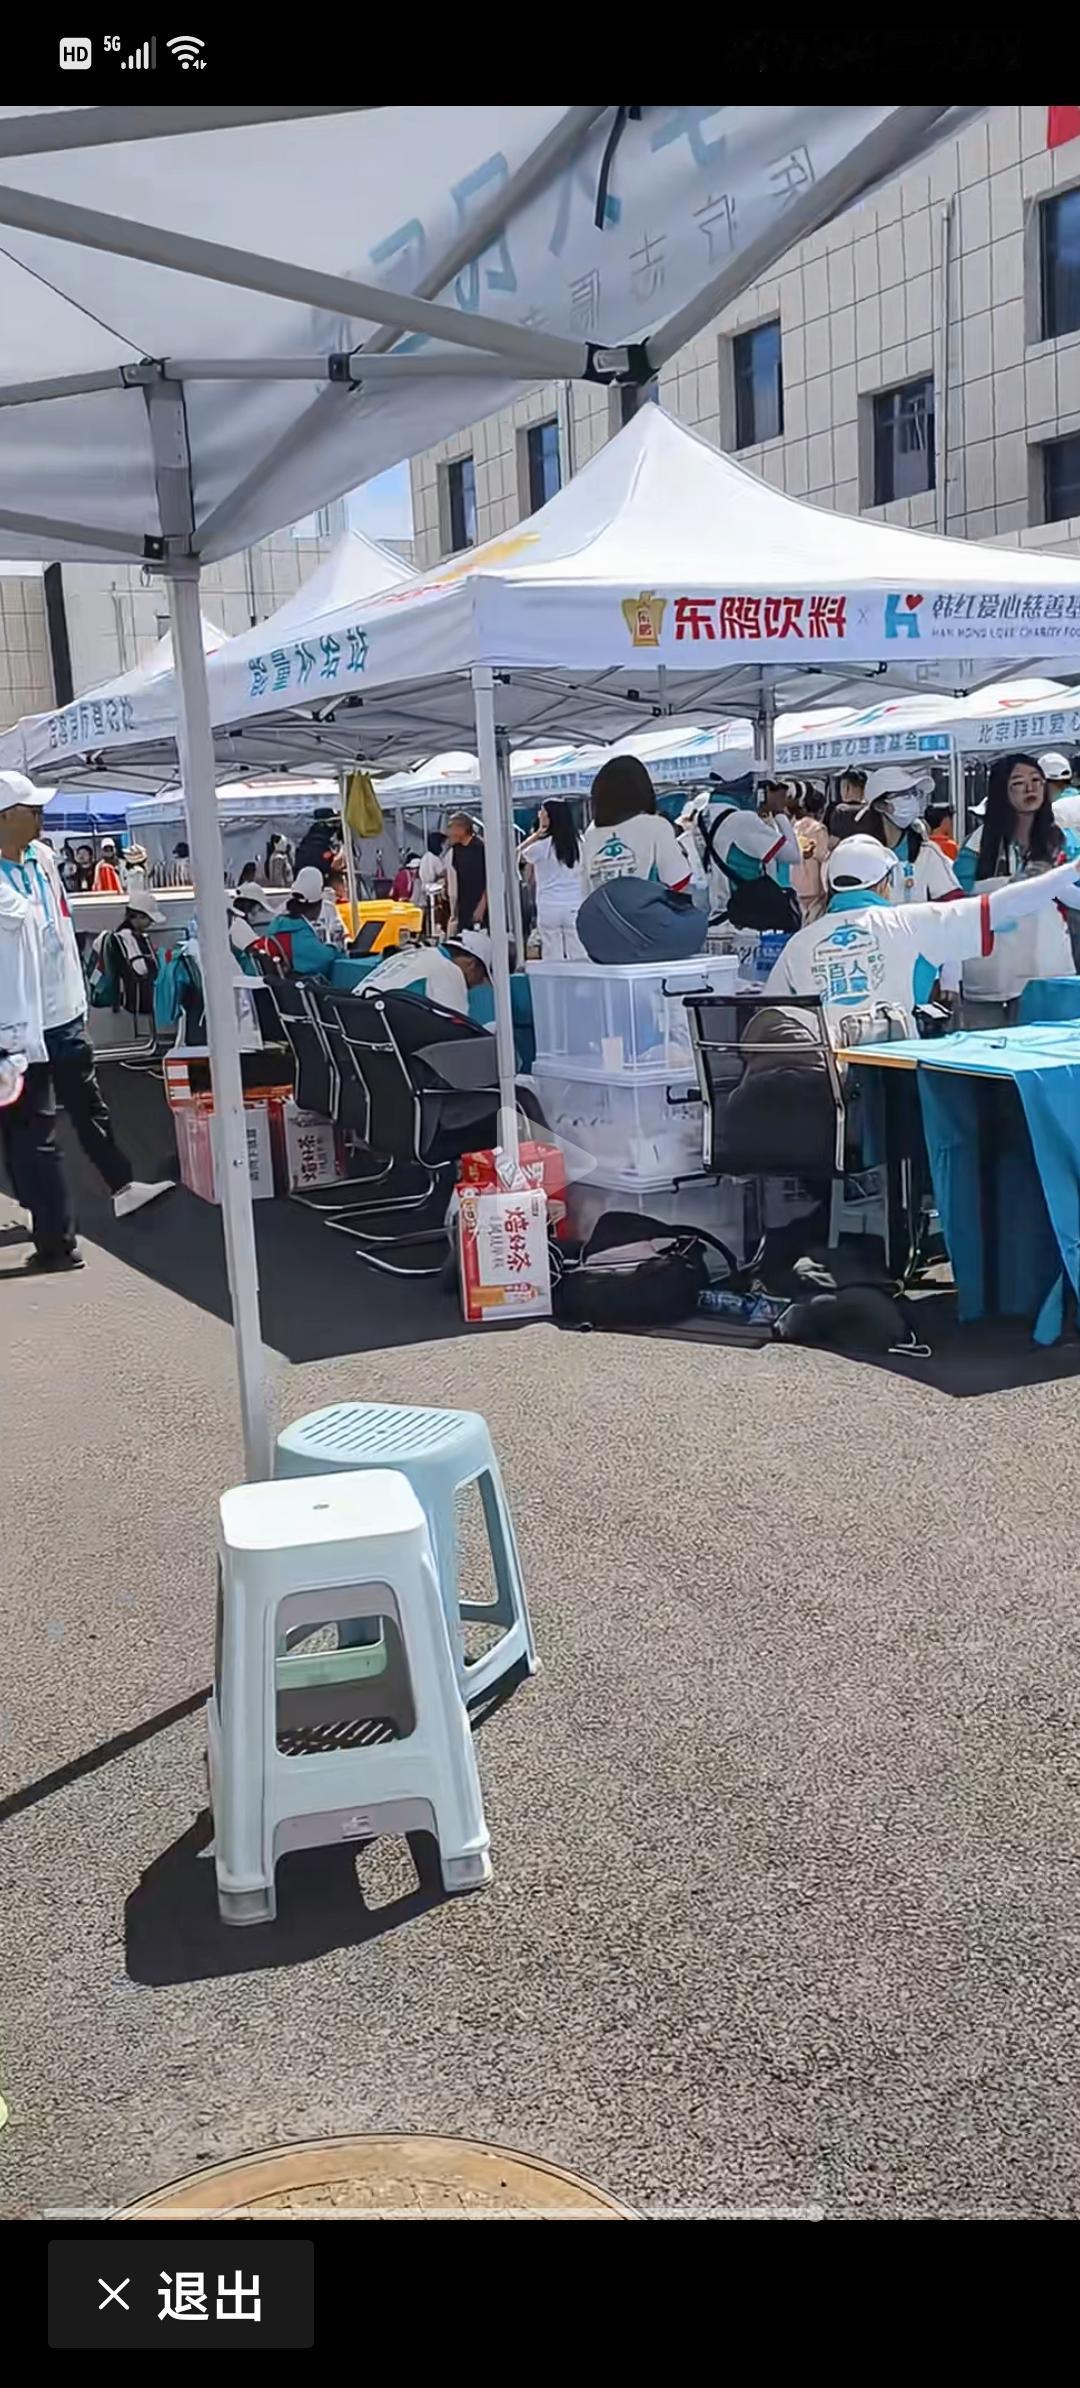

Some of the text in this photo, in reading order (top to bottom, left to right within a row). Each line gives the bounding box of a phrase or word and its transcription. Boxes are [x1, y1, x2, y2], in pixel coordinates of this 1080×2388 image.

[674, 596, 847, 640] 东鹏饮料
[932, 594, 1080, 619] 韩红爱心慈善基
[504, 1206, 532, 1273] 焙好茶
